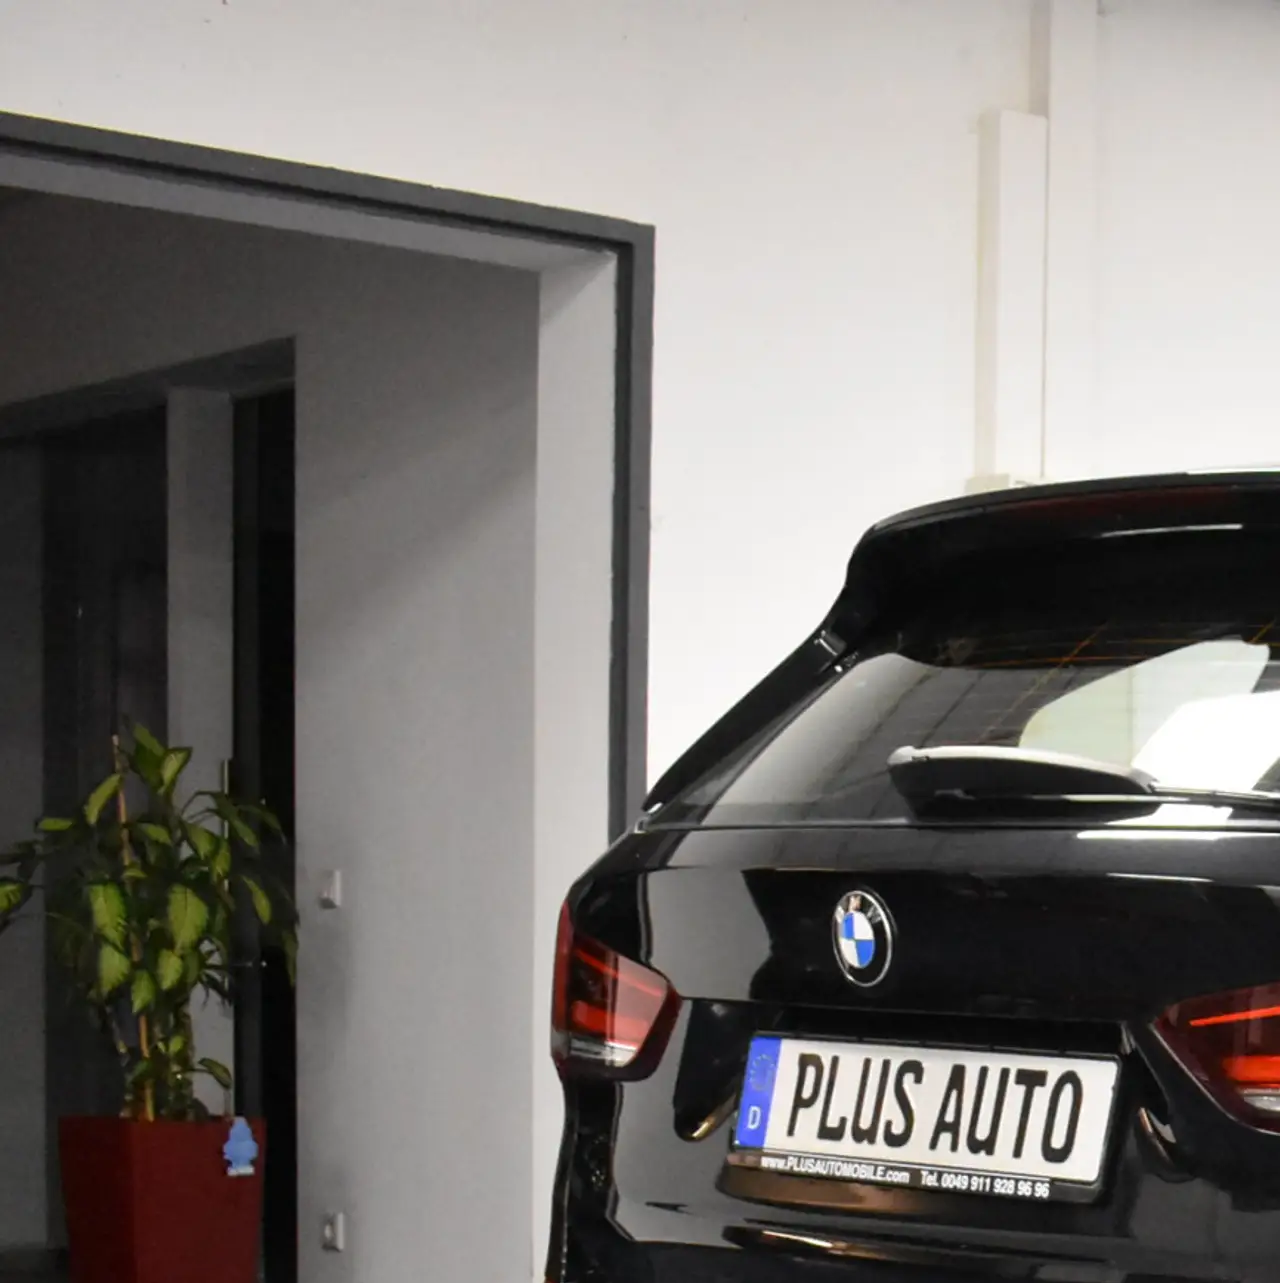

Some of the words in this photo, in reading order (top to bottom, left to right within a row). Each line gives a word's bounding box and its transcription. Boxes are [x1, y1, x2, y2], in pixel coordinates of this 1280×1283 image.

[787, 1053, 924, 1148] PLUS
[929, 1064, 1084, 1163] AUTO
[760, 1156, 910, 1183] www.PLUSAUTOMOBILE.com
[920, 1170, 939, 1184] Tel.
[941, 1173, 968, 1189] 0049
[970, 1176, 990, 1191] 911
[993, 1178, 1015, 1195] 928
